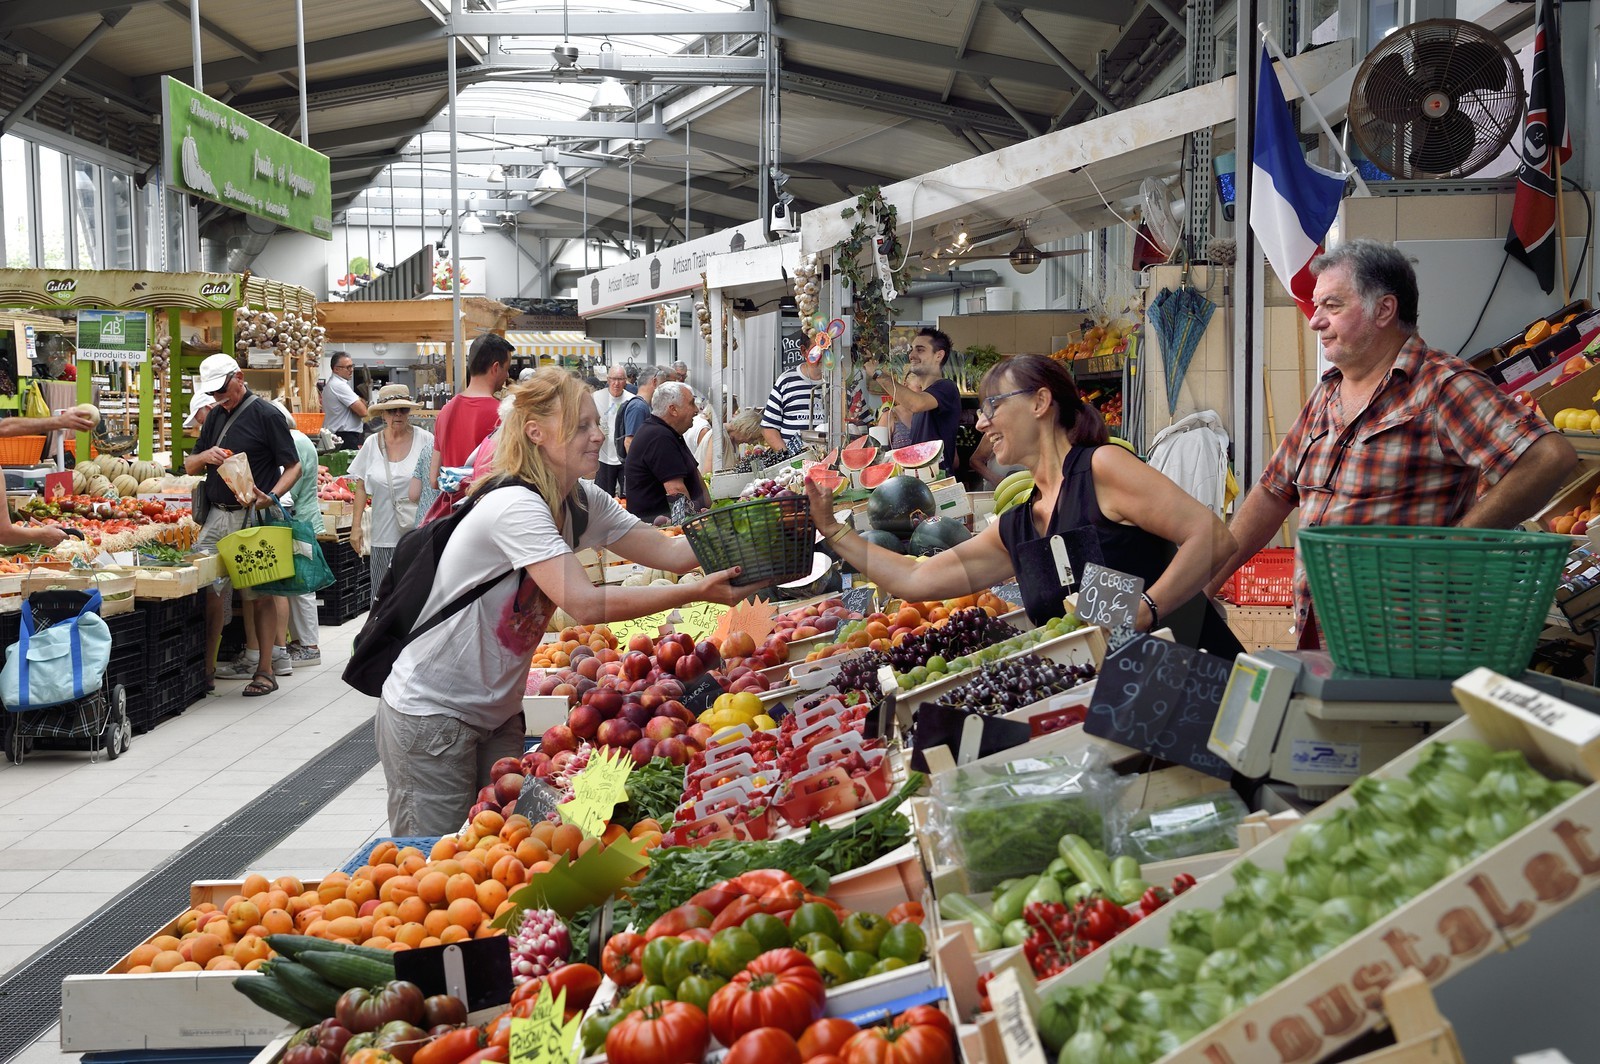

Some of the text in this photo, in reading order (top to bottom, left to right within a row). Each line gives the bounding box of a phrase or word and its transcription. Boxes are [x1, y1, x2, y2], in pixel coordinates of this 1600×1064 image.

[607, 276, 622, 292] Artisan
[622, 272, 640, 288] Traiteur
[672, 257, 692, 274] Artisan
[83, 350, 141, 360] ici produits Bio
